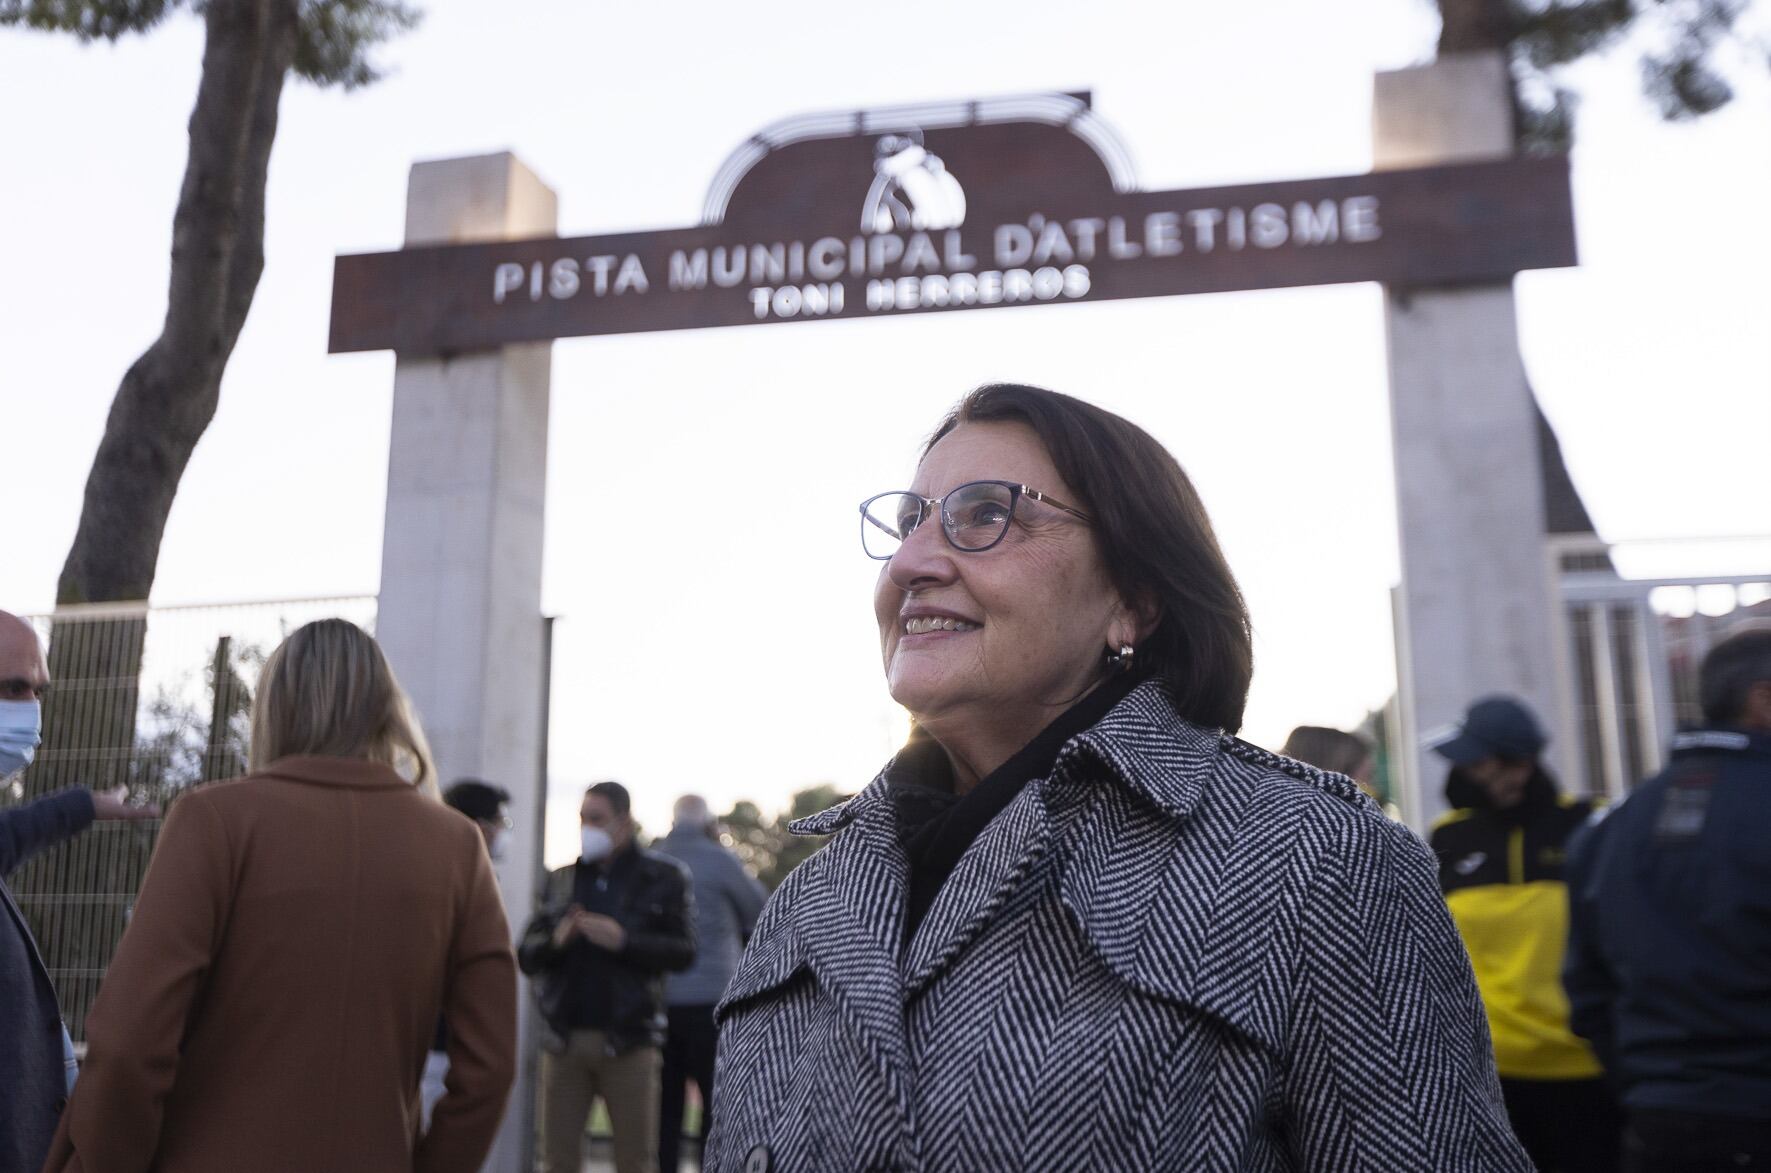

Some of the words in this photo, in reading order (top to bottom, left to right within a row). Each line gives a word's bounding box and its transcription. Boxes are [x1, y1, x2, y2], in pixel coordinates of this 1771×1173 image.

[494, 253, 649, 303] PISTA
[668, 230, 976, 291] MUNICIPAL
[993, 196, 1382, 268] D'ATLETISME
[748, 282, 845, 319] TONI
[866, 264, 1091, 311] HERREROS
